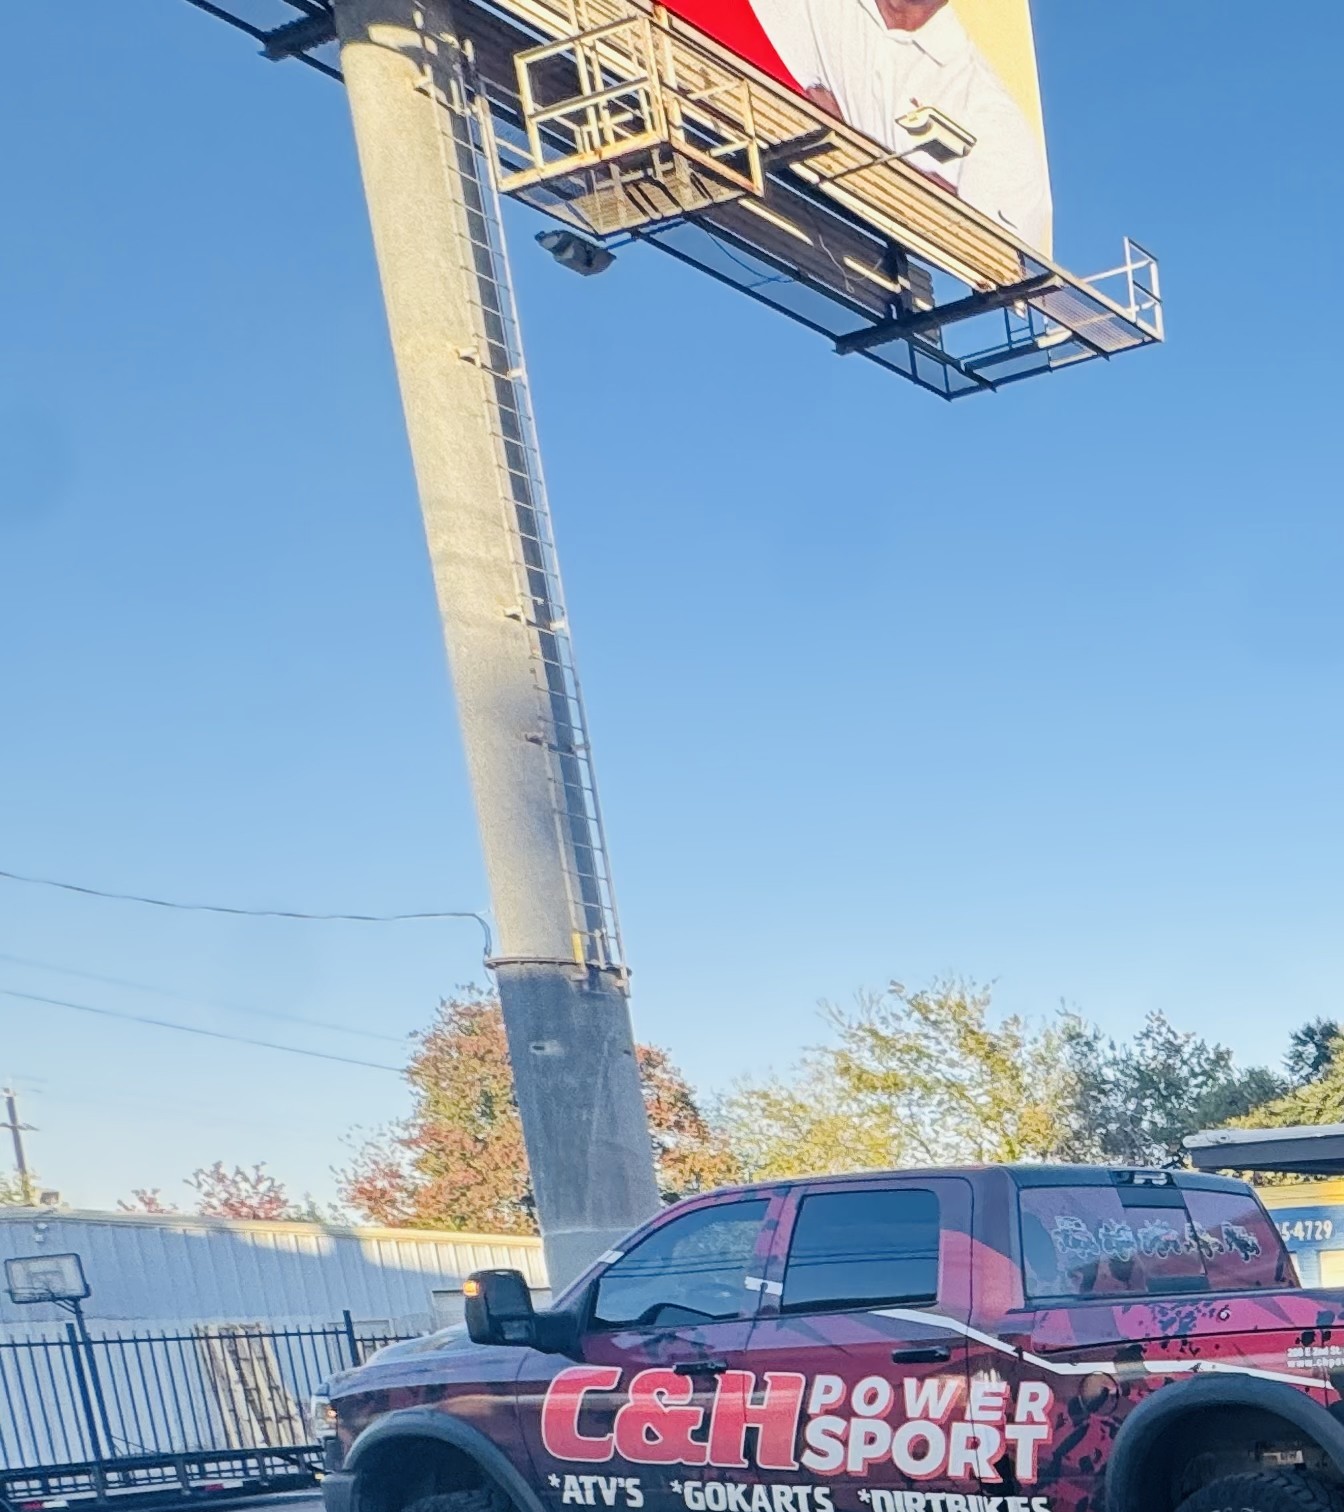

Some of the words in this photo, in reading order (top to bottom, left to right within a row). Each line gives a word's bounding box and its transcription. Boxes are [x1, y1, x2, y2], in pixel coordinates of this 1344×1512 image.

[1275, 1219, 1333, 1242] 5-4729
[541, 1366, 805, 1470] C&H
[807, 1374, 1054, 1425] POWER
[800, 1415, 1053, 1485] SPORT
